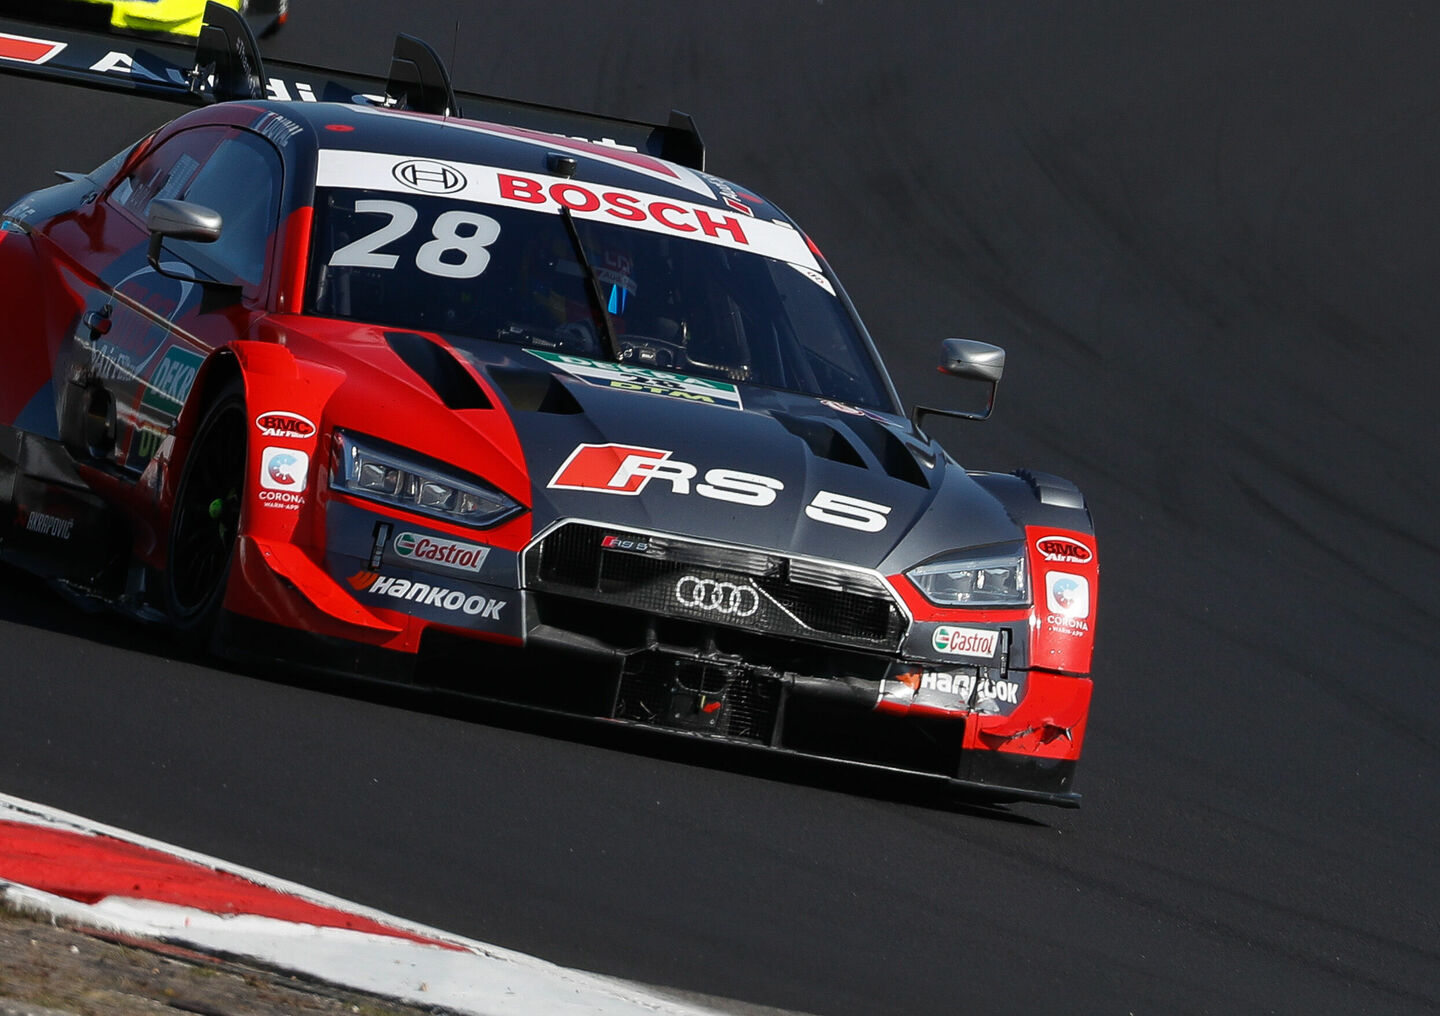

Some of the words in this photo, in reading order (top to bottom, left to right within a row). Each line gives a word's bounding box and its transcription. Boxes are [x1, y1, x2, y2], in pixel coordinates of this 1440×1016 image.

[496, 172, 750, 246] BOSCH
[328, 199, 501, 279] 28
[610, 381, 715, 403] DTM
[263, 416, 310, 434] BMC
[258, 490, 306, 505] CORONA
[607, 454, 784, 507] RS
[805, 490, 893, 533] 5
[414, 538, 483, 569] Castrol
[1043, 541, 1087, 560] BMC
[1047, 615, 1089, 631] CORONA
[950, 631, 994, 656] Castrol
